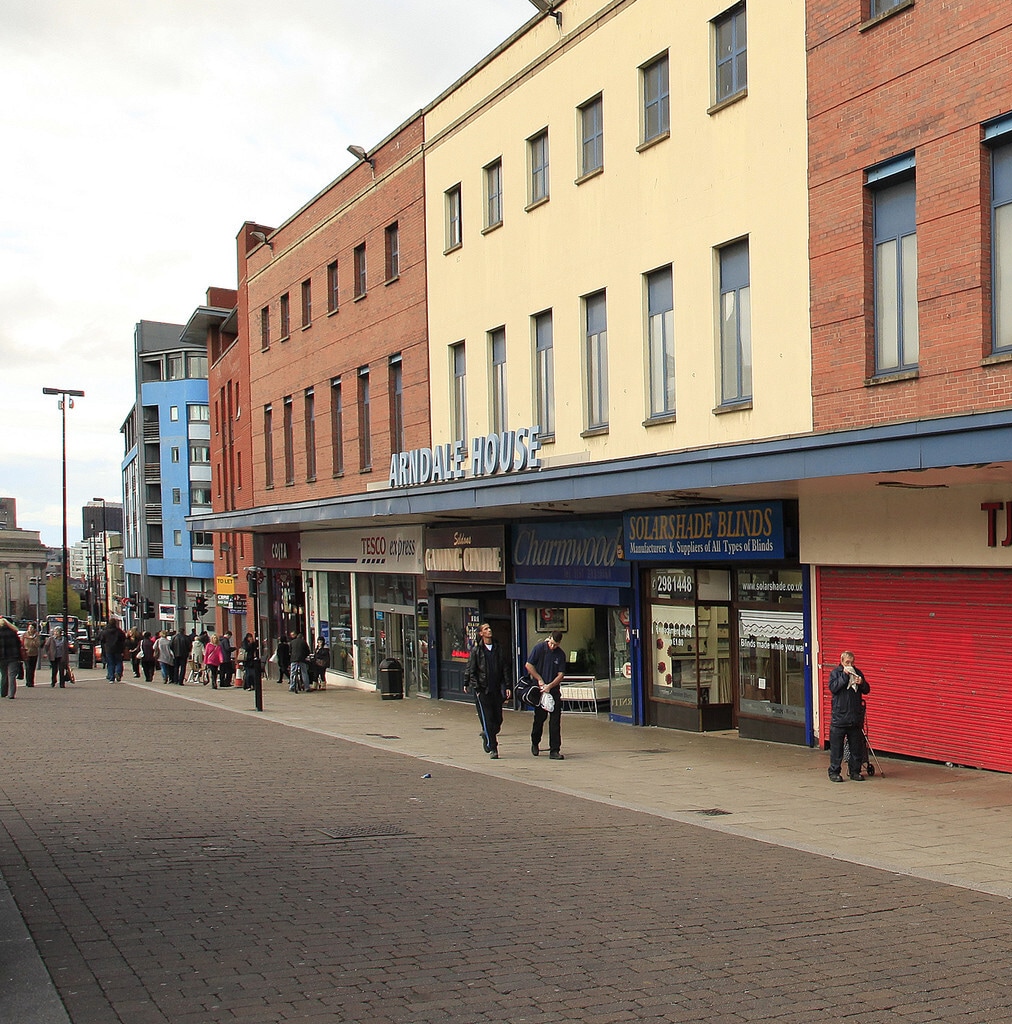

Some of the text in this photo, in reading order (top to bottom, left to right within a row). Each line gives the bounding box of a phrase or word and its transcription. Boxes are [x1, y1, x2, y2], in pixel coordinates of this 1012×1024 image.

[388, 425, 542, 487] ARNDALE HOUSE
[629, 507, 773, 540] SOLARSHADE BLINDS
[361, 535, 415, 562] TESCO express
[513, 527, 623, 567] Charmwood
[629, 538, 774, 555] Manufacturers & Suppliers of All Types of Blinds
[657, 575, 692, 593] 2981448
[742, 580, 803, 593] www.solarshade.co.uk
[740, 638, 756, 648] Blinds
[756, 640, 770, 649] made
[770, 640, 784, 650] while
[785, 643, 795, 653] you
